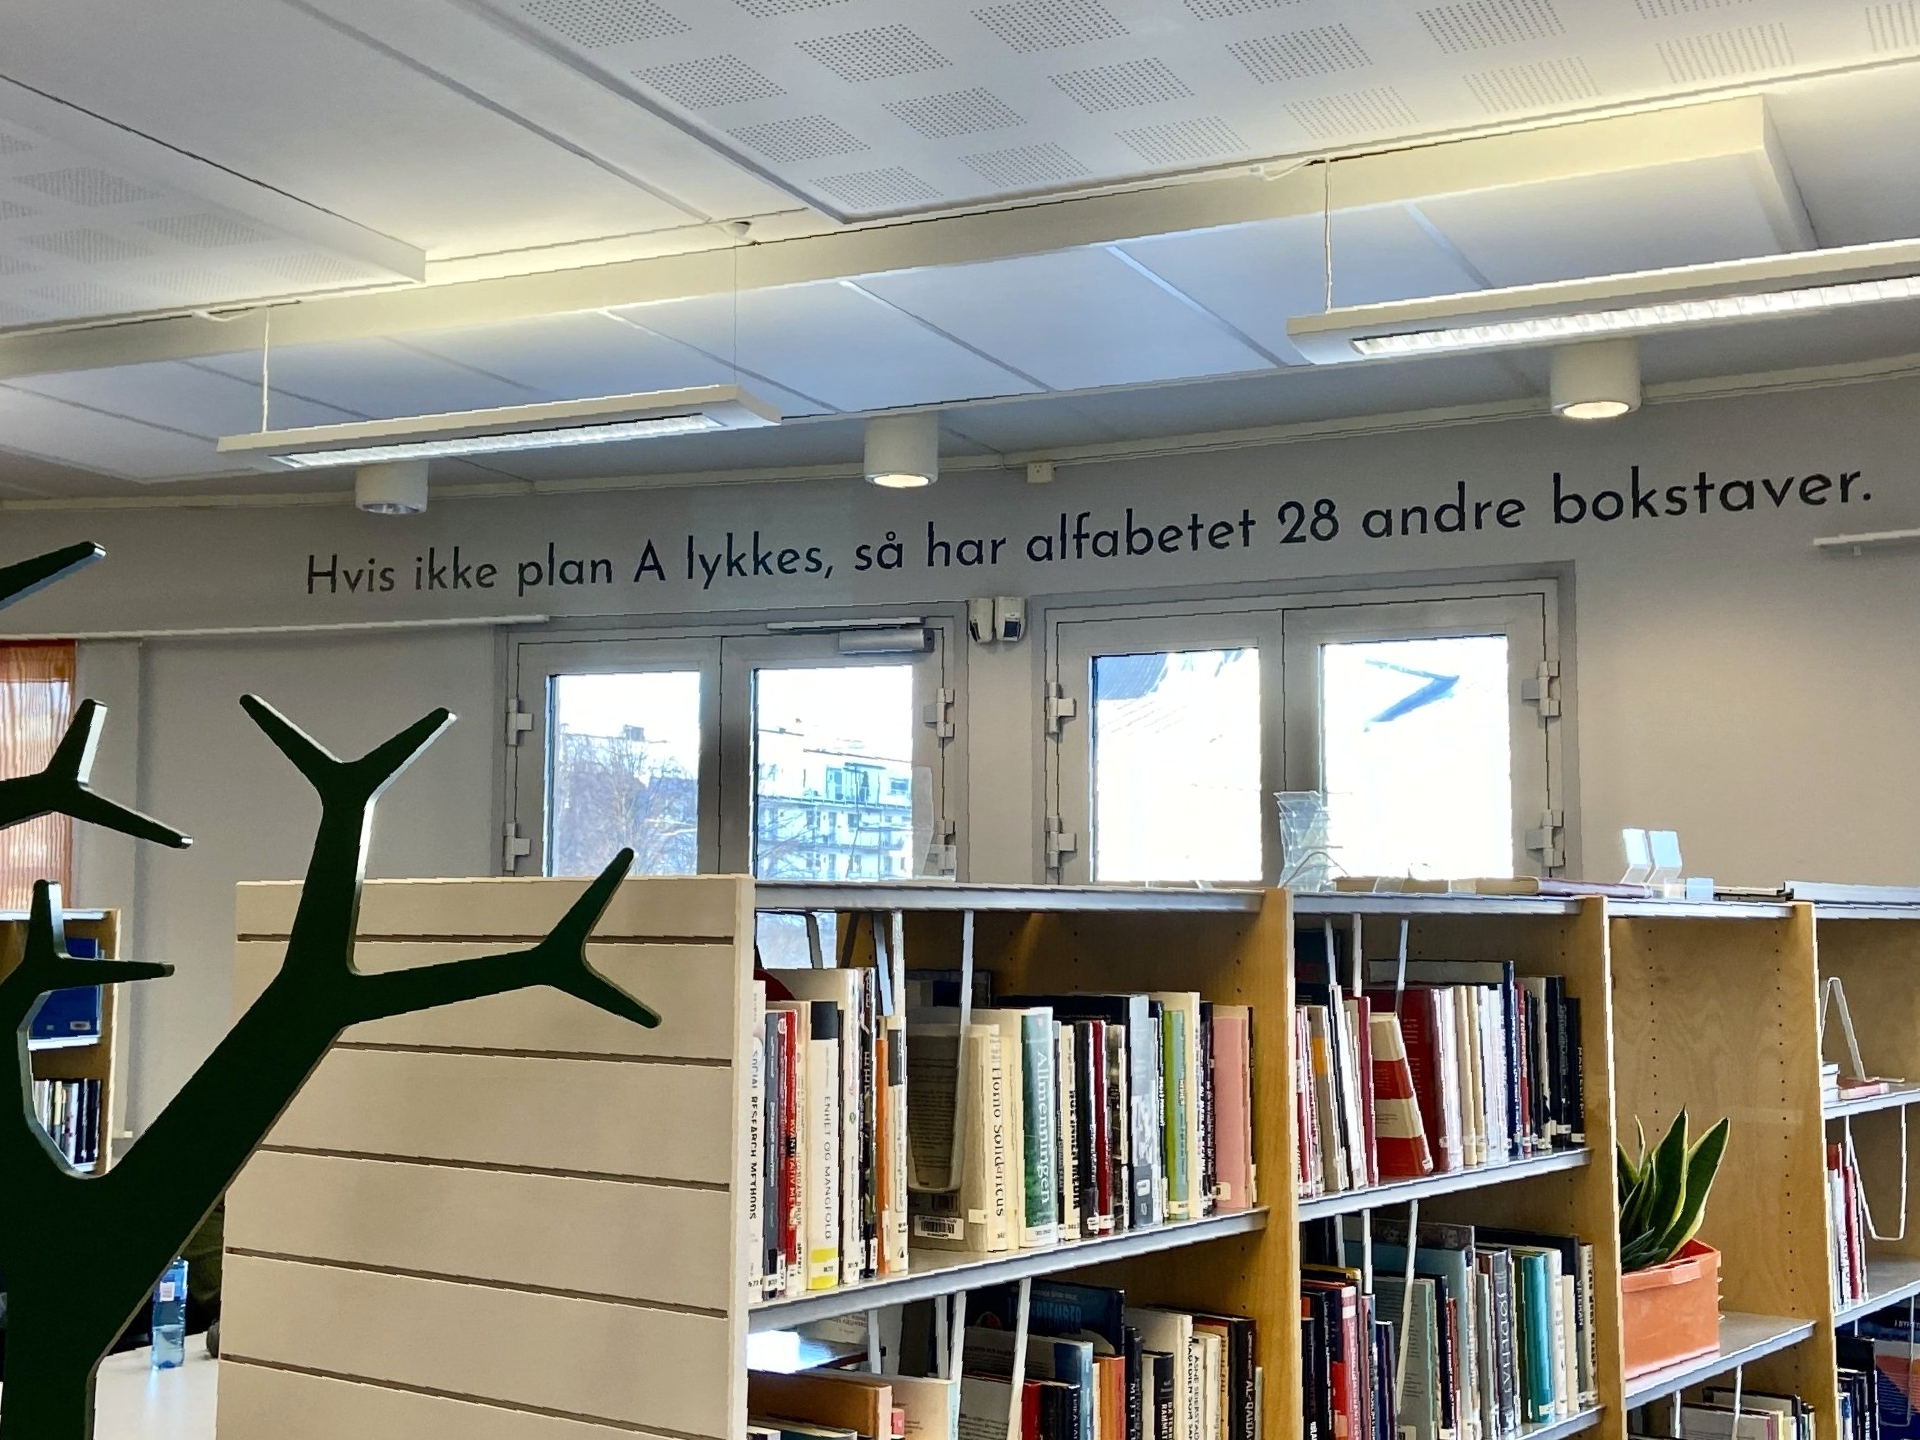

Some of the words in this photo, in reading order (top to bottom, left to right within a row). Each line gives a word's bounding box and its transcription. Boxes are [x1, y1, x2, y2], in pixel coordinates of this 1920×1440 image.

[308, 554, 394, 594] Hvis
[416, 546, 497, 590] ikke
[518, 542, 612, 597] plan
[634, 539, 666, 582] A
[687, 531, 833, 589] lykkes,
[855, 531, 903, 571] så
[928, 521, 1006, 566] har
[1027, 508, 1256, 561] alfabetet
[1278, 499, 1339, 543] 28
[1362, 481, 1525, 538] andre
[1553, 466, 1871, 524] bokstaver.
[823, 1095, 832, 1135] ENHET
[992, 1067, 1002, 1118] Homo
[749, 1096, 759, 1157] RESEARCH
[789, 1118, 797, 1185] KVANTITATIV
[824, 1142, 832, 1161] OG
[1036, 1051, 1051, 1204] Allmenningen
[749, 1162, 758, 1219] METHODS
[824, 1165, 833, 1240] MANGFOLD
[993, 1125, 1005, 1217] Solidaricus
